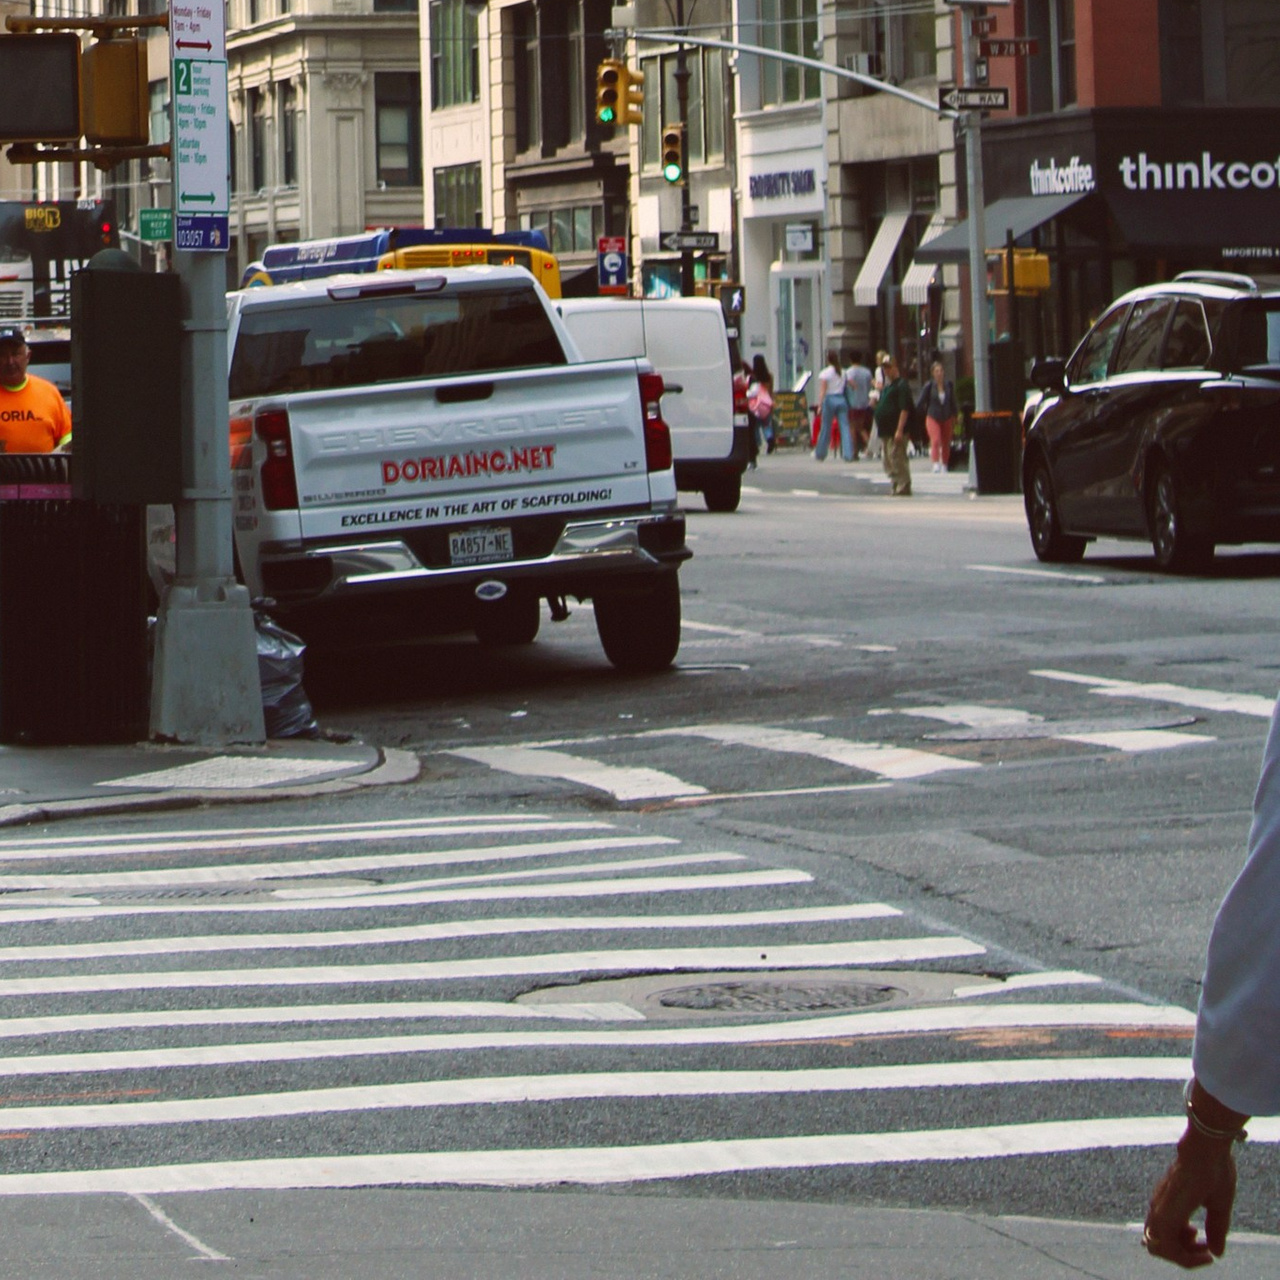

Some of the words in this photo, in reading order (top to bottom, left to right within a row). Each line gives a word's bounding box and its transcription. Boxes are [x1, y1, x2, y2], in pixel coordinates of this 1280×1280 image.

[174, 5, 193, 20] Monday
[197, 6, 212, 20] Friday
[179, 62, 188, 92] 2
[950, 94, 968, 106] ONE
[980, 93, 1002, 106] WAY
[25, 208, 45, 219] BIG
[178, 229, 204, 246] 103057
[1222, 247, 1273, 258] IMPORTERS
[318, 405, 620, 453] CHEVROLET
[380, 444, 557, 485] DORIAINC.NET
[303, 487, 387, 503] SILVERADO
[341, 507, 423, 527] EXCELLENCE
[425, 506, 440, 518] IN
[442, 503, 469, 517] THE
[471, 500, 498, 514] ART
[501, 498, 519, 511] OF
[521, 488, 612, 508] SCAFFOLDING!
